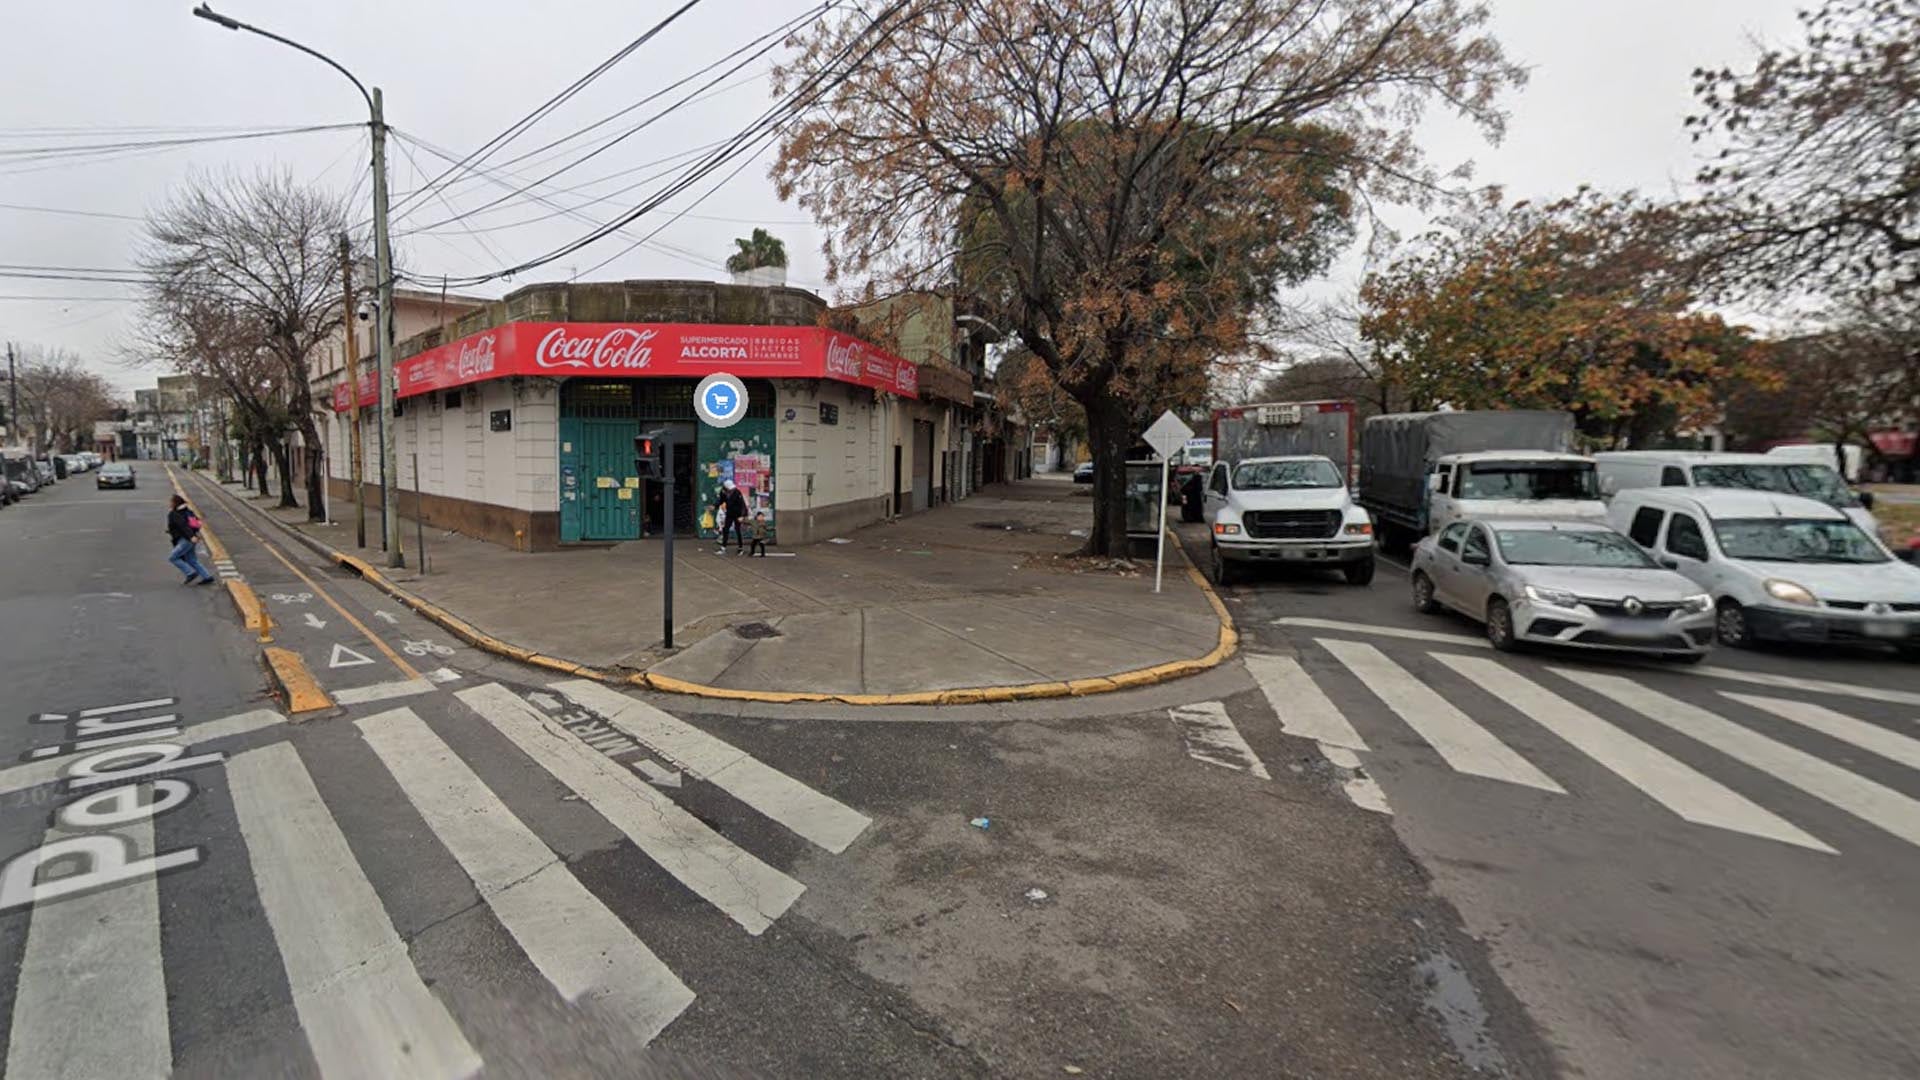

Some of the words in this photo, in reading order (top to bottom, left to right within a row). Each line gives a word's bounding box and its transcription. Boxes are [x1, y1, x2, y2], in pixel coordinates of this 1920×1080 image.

[680, 336, 748, 344] SUPERMERCADO
[536, 328, 658, 368] Coca-Cola
[681, 346, 747, 358] ALCORTA
